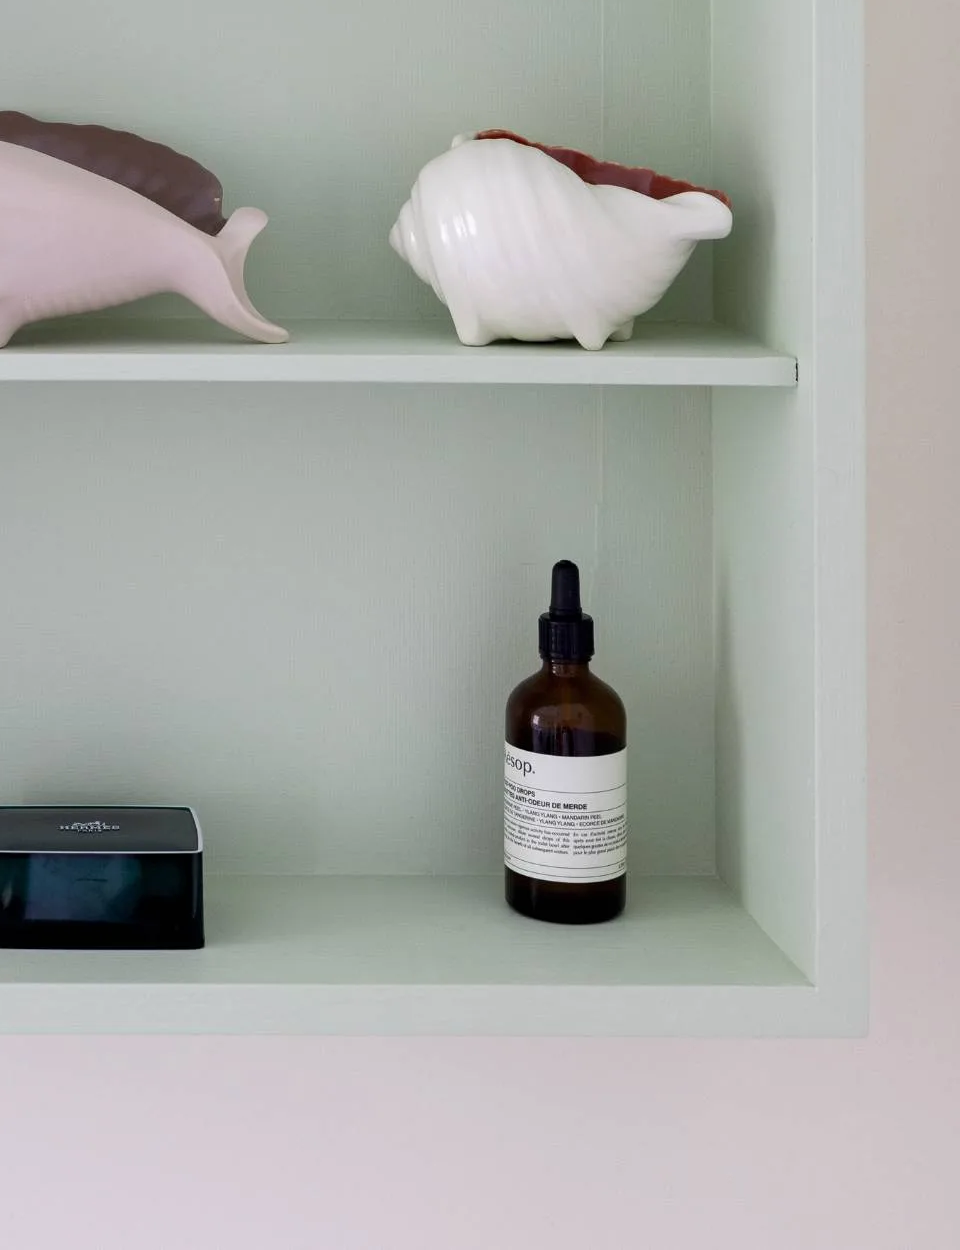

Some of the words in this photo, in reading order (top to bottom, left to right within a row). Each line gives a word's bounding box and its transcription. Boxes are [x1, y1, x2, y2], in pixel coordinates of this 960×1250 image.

[517, 787, 536, 798] DROPS
[515, 795, 551, 809] ANTI-ODEUR
[540, 812, 558, 820] YLANG
